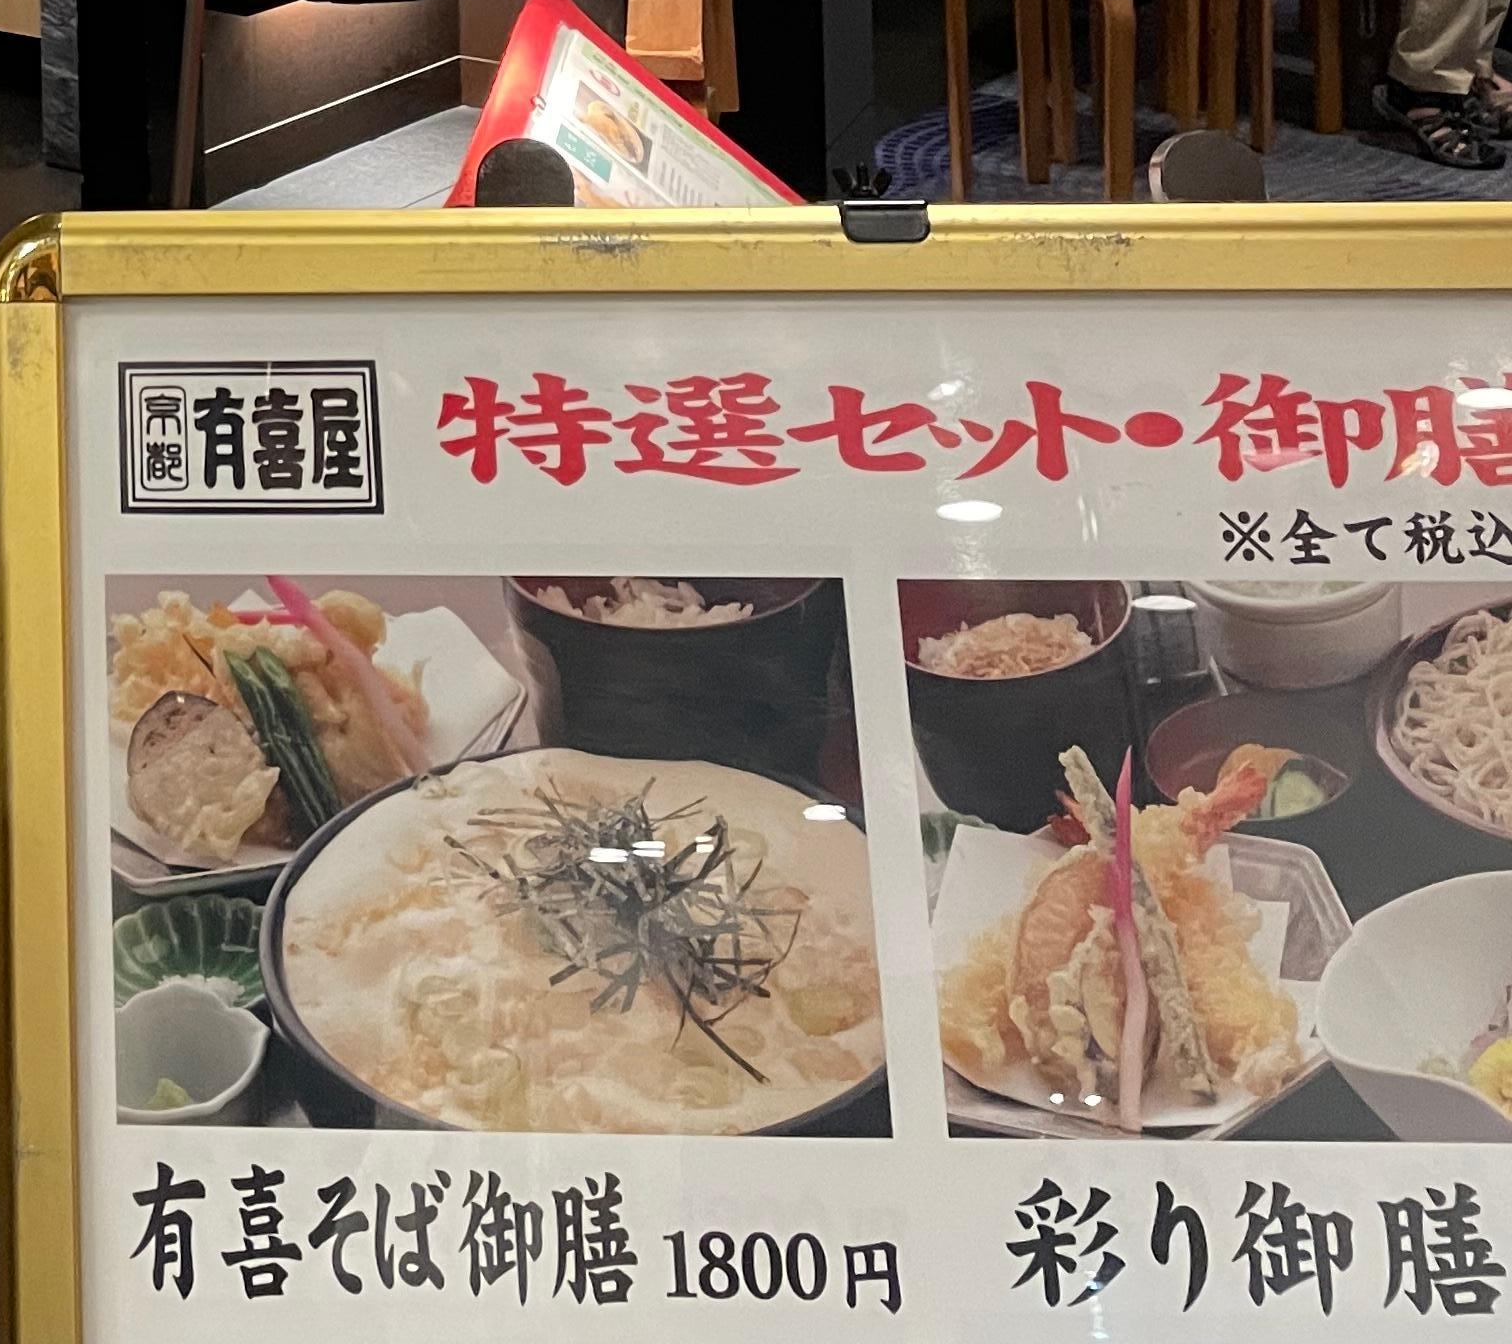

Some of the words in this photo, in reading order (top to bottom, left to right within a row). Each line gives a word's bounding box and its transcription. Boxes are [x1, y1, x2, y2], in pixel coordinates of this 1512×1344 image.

[144, 393, 184, 482] 京都
[193, 387, 364, 490] 有喜屋
[129, 1160, 641, 1307] 有喜そば御膳
[663, 1229, 904, 1315] 1800円
[1005, 1177, 1508, 1318] 彩り御膳
